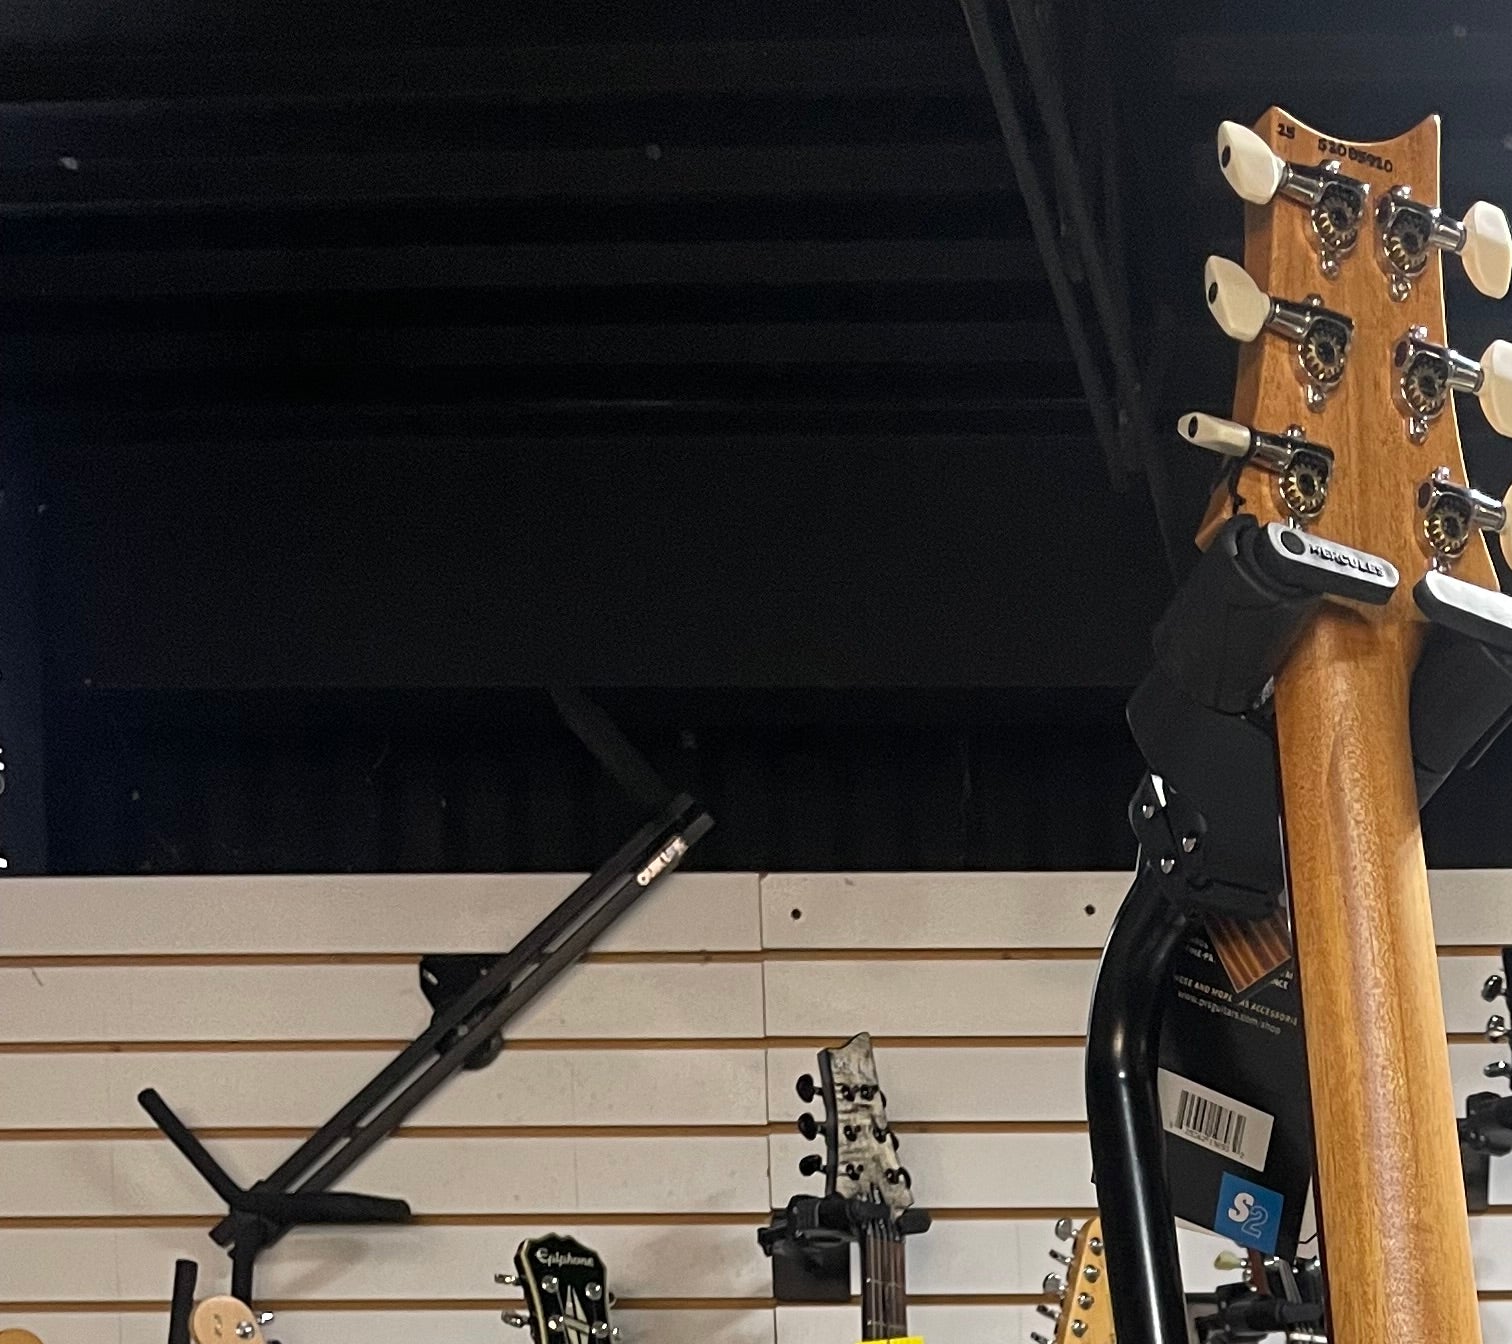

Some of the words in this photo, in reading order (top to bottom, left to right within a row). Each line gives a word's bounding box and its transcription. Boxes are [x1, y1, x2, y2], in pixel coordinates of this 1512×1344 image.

[1308, 543, 1385, 577] HERCULES
[1227, 1192, 1269, 1240] S2
[535, 1247, 595, 1268] Epiphone
